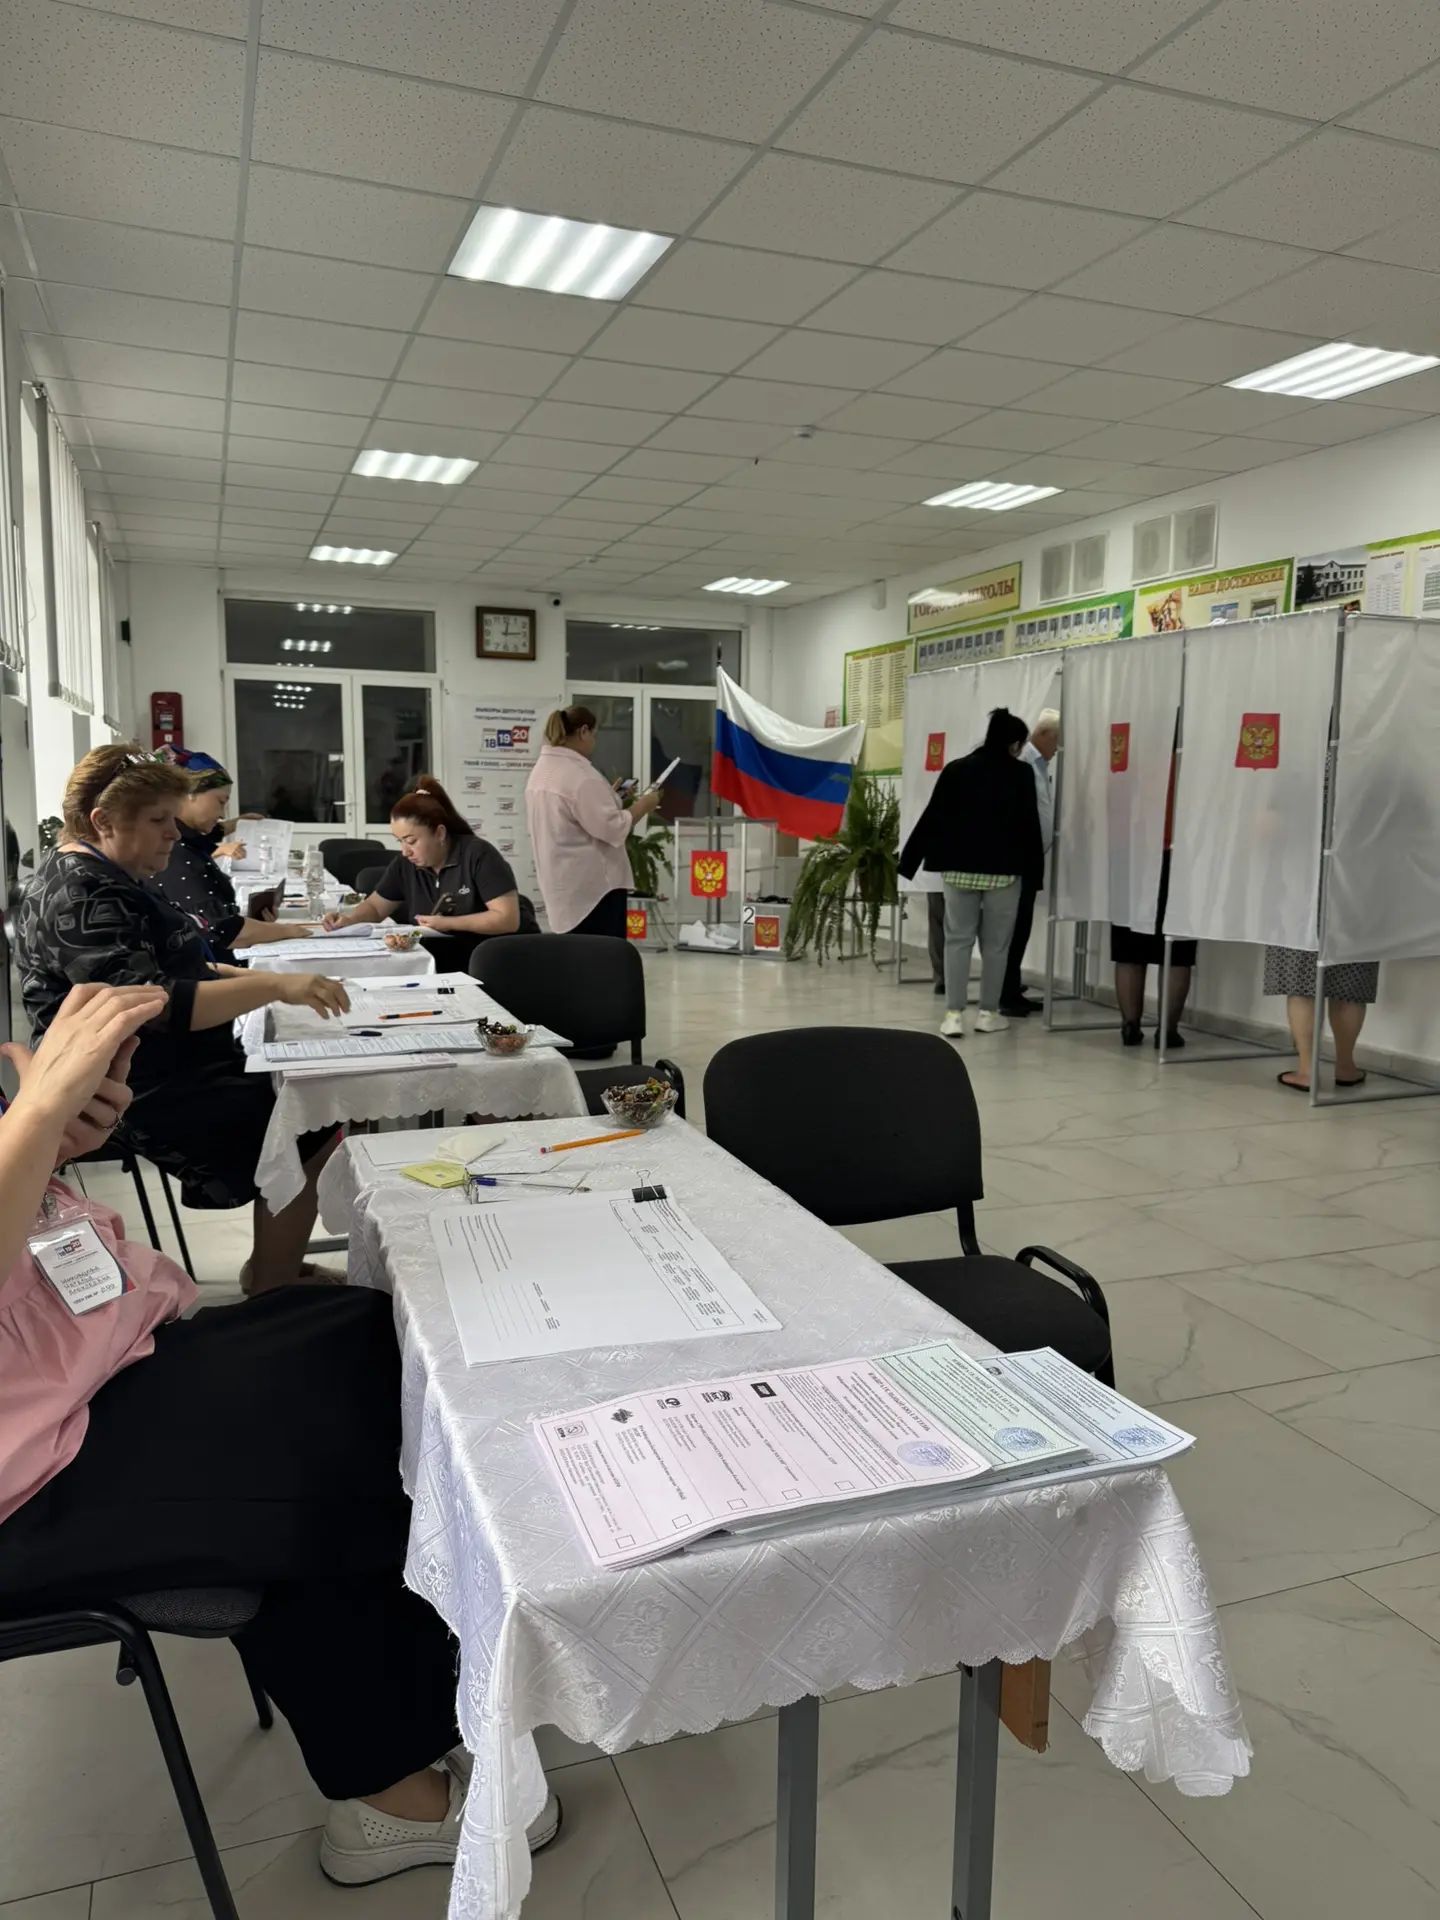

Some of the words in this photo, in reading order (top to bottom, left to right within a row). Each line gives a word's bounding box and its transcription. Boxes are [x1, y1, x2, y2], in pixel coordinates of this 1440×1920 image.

[485, 738, 497, 748] 18
[498, 733, 511, 744] 19
[513, 728, 527, 740] 20
[743, 906, 755, 925] 2
